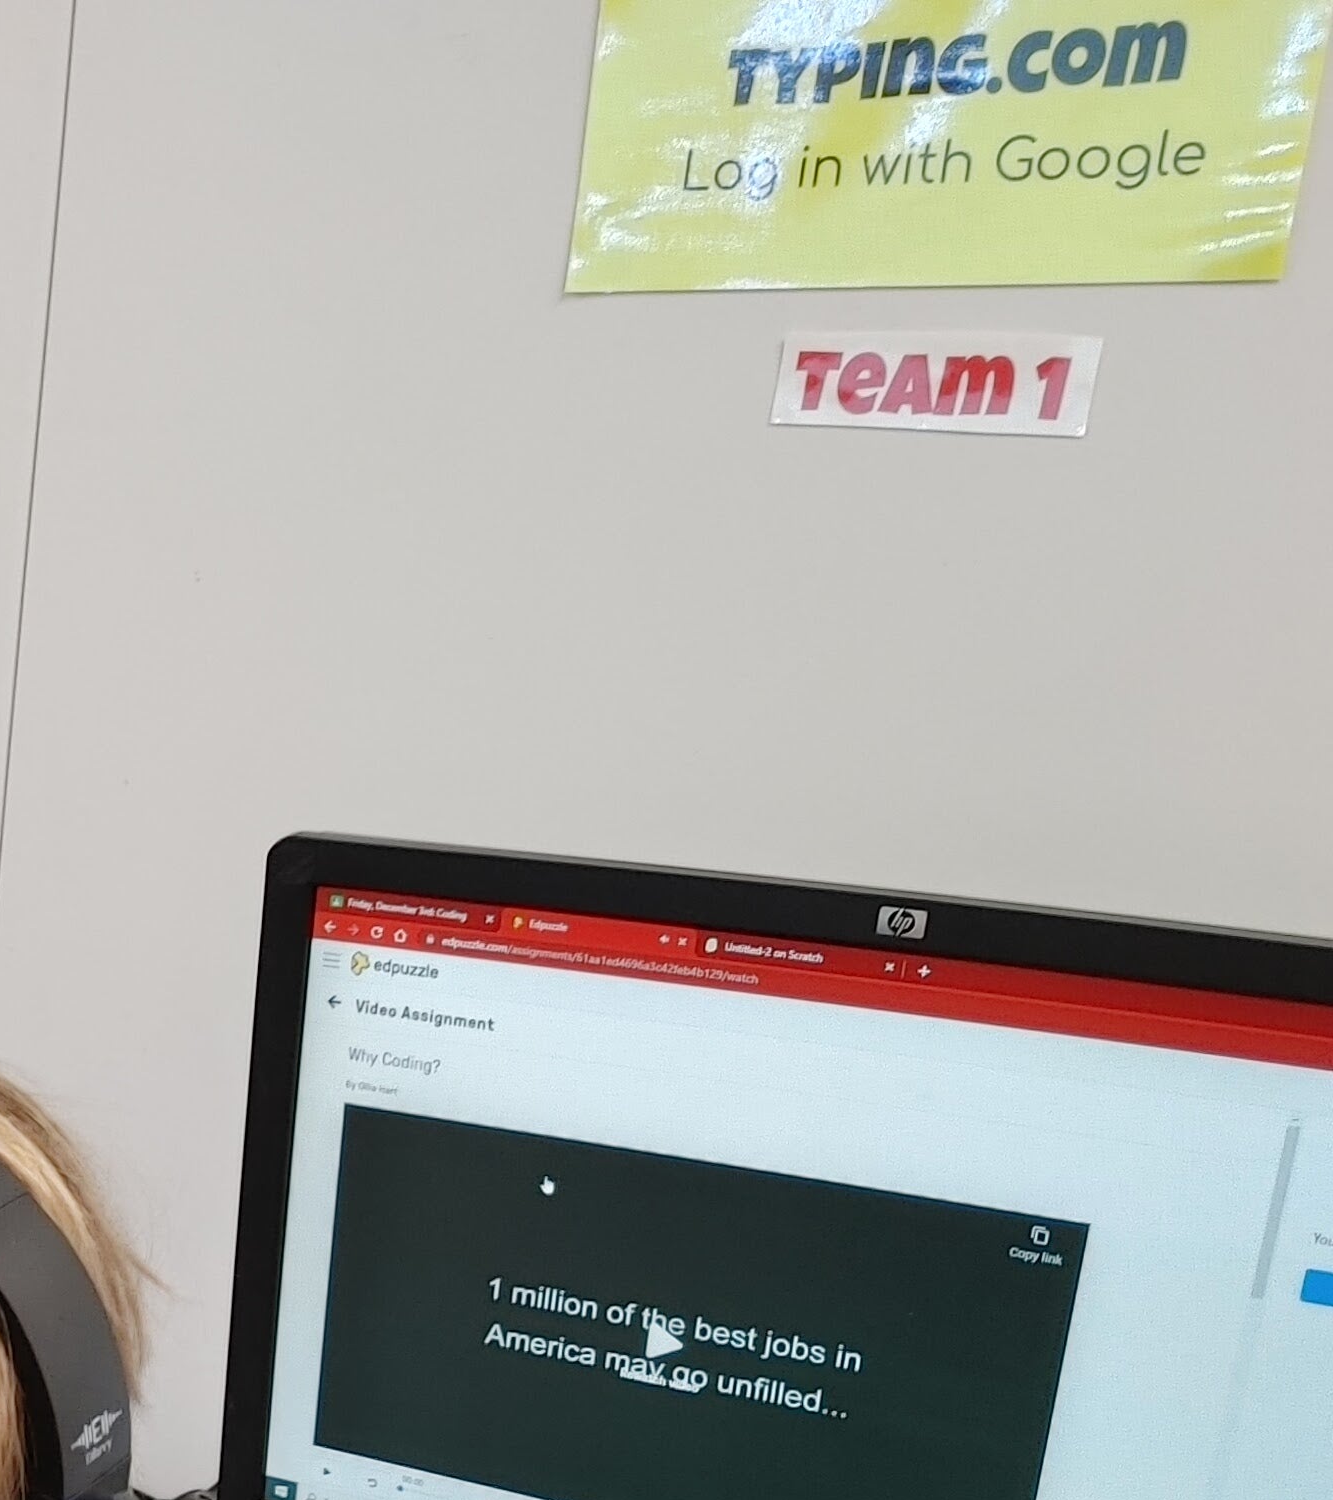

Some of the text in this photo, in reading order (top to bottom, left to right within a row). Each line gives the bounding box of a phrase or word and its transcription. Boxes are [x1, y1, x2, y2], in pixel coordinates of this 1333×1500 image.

[683, 130, 1206, 200] Log in with Google
[1036, 356, 1073, 420] 1
[373, 957, 439, 980] edpuzzle
[788, 949, 824, 964] Scratch
[355, 999, 496, 1032] Video Assignment
[348, 1047, 441, 1076] Why Coding?
[1009, 1246, 1063, 1267] Copy link
[489, 1277, 863, 1372] 1 million of the best jobs in
[484, 1323, 597, 1366] America
[718, 1373, 848, 1420] unfilled...
